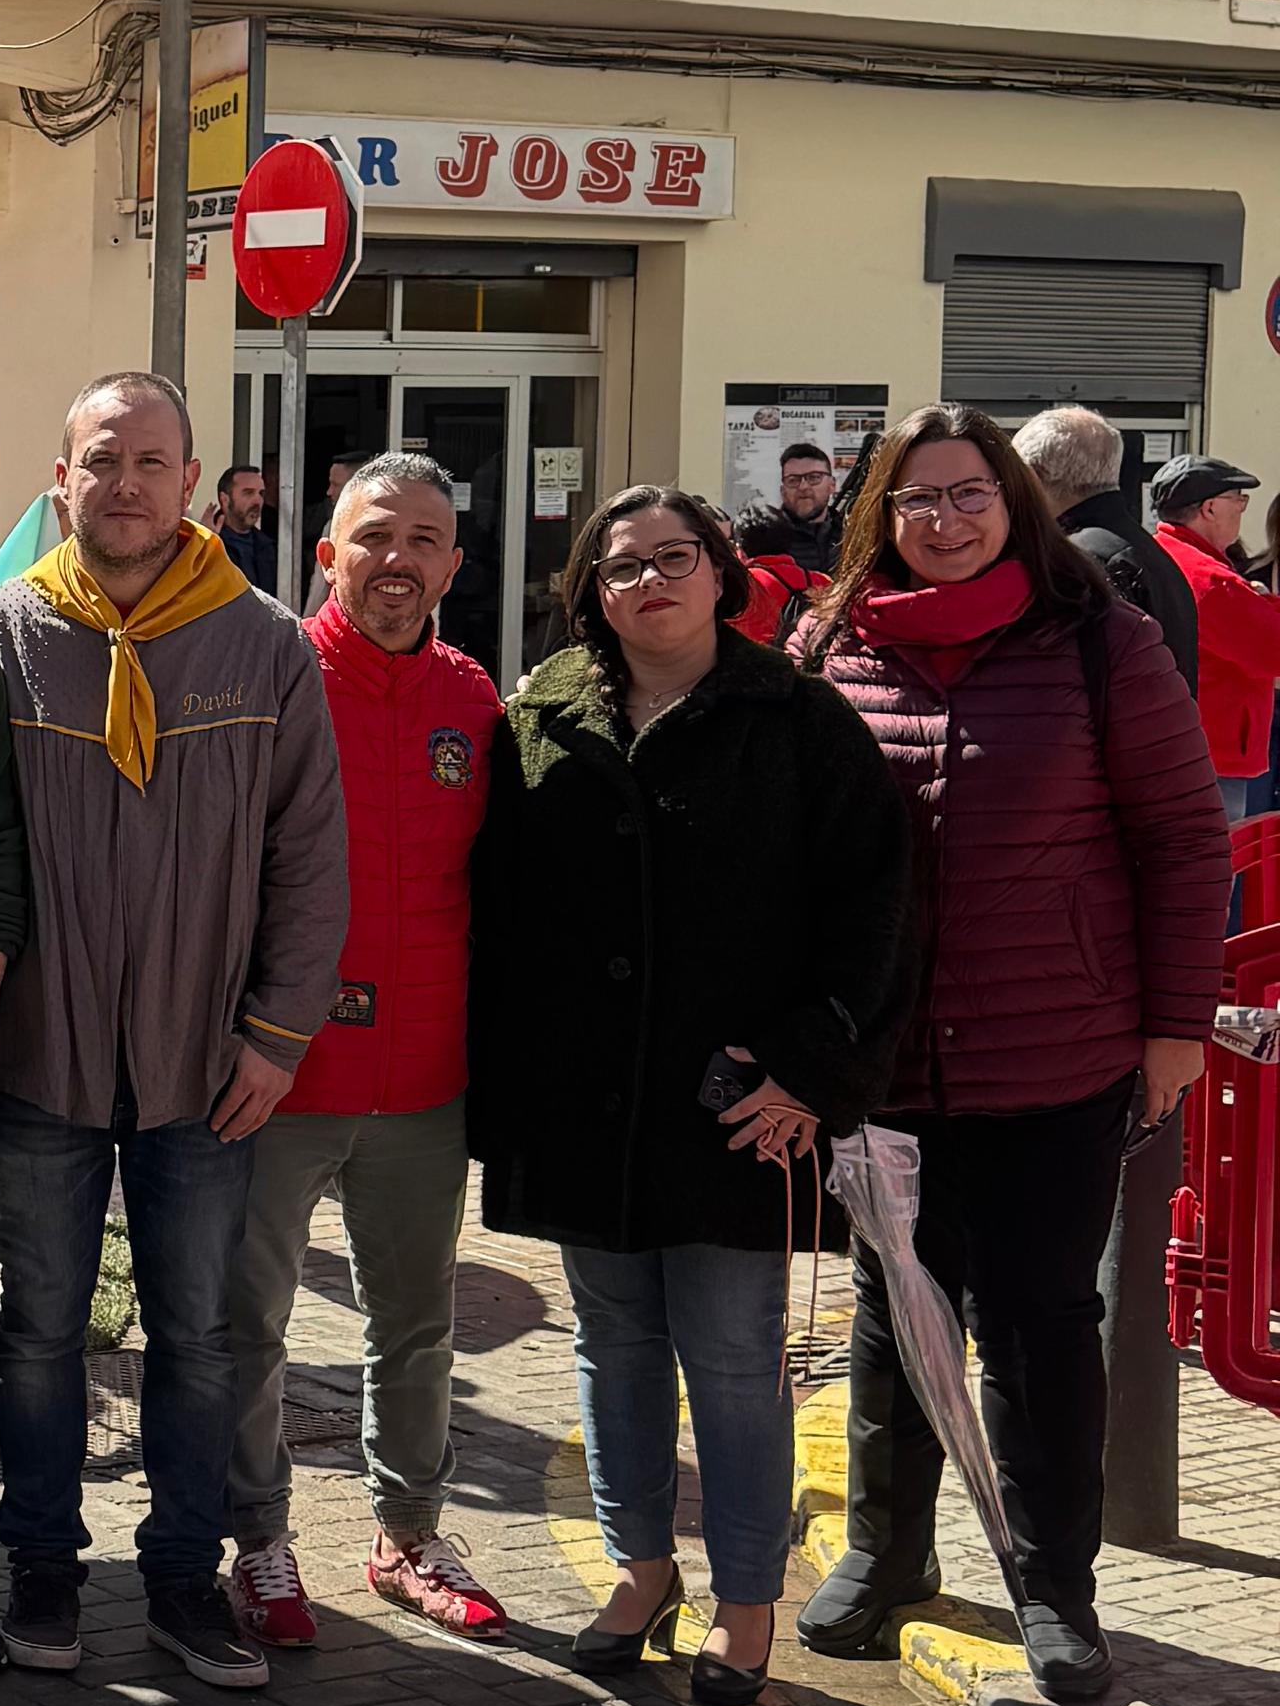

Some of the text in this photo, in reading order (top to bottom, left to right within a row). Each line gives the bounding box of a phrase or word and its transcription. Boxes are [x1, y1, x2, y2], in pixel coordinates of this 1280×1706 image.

[189, 93, 238, 133] iguel
[435, 131, 706, 207] JOSE
[187, 195, 238, 219] OSE
[183, 683, 244, 716] David
